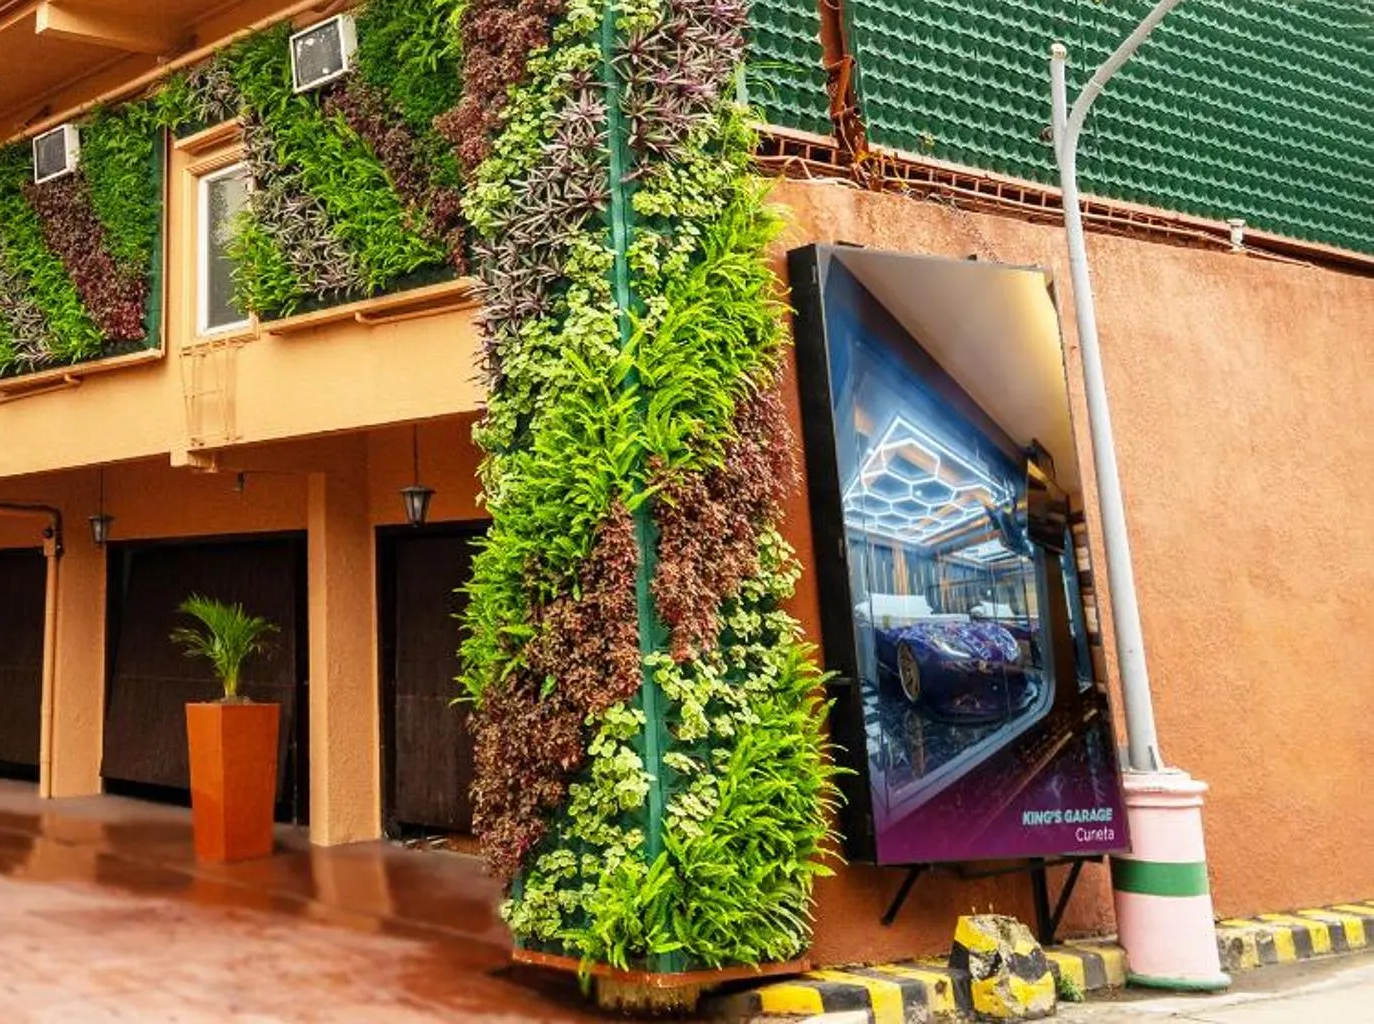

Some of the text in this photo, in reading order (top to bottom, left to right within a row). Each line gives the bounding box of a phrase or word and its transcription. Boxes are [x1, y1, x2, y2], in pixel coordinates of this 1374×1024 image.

[1022, 808, 1113, 825] KING'S GARAGE
[1075, 826, 1115, 842] Cuneta
